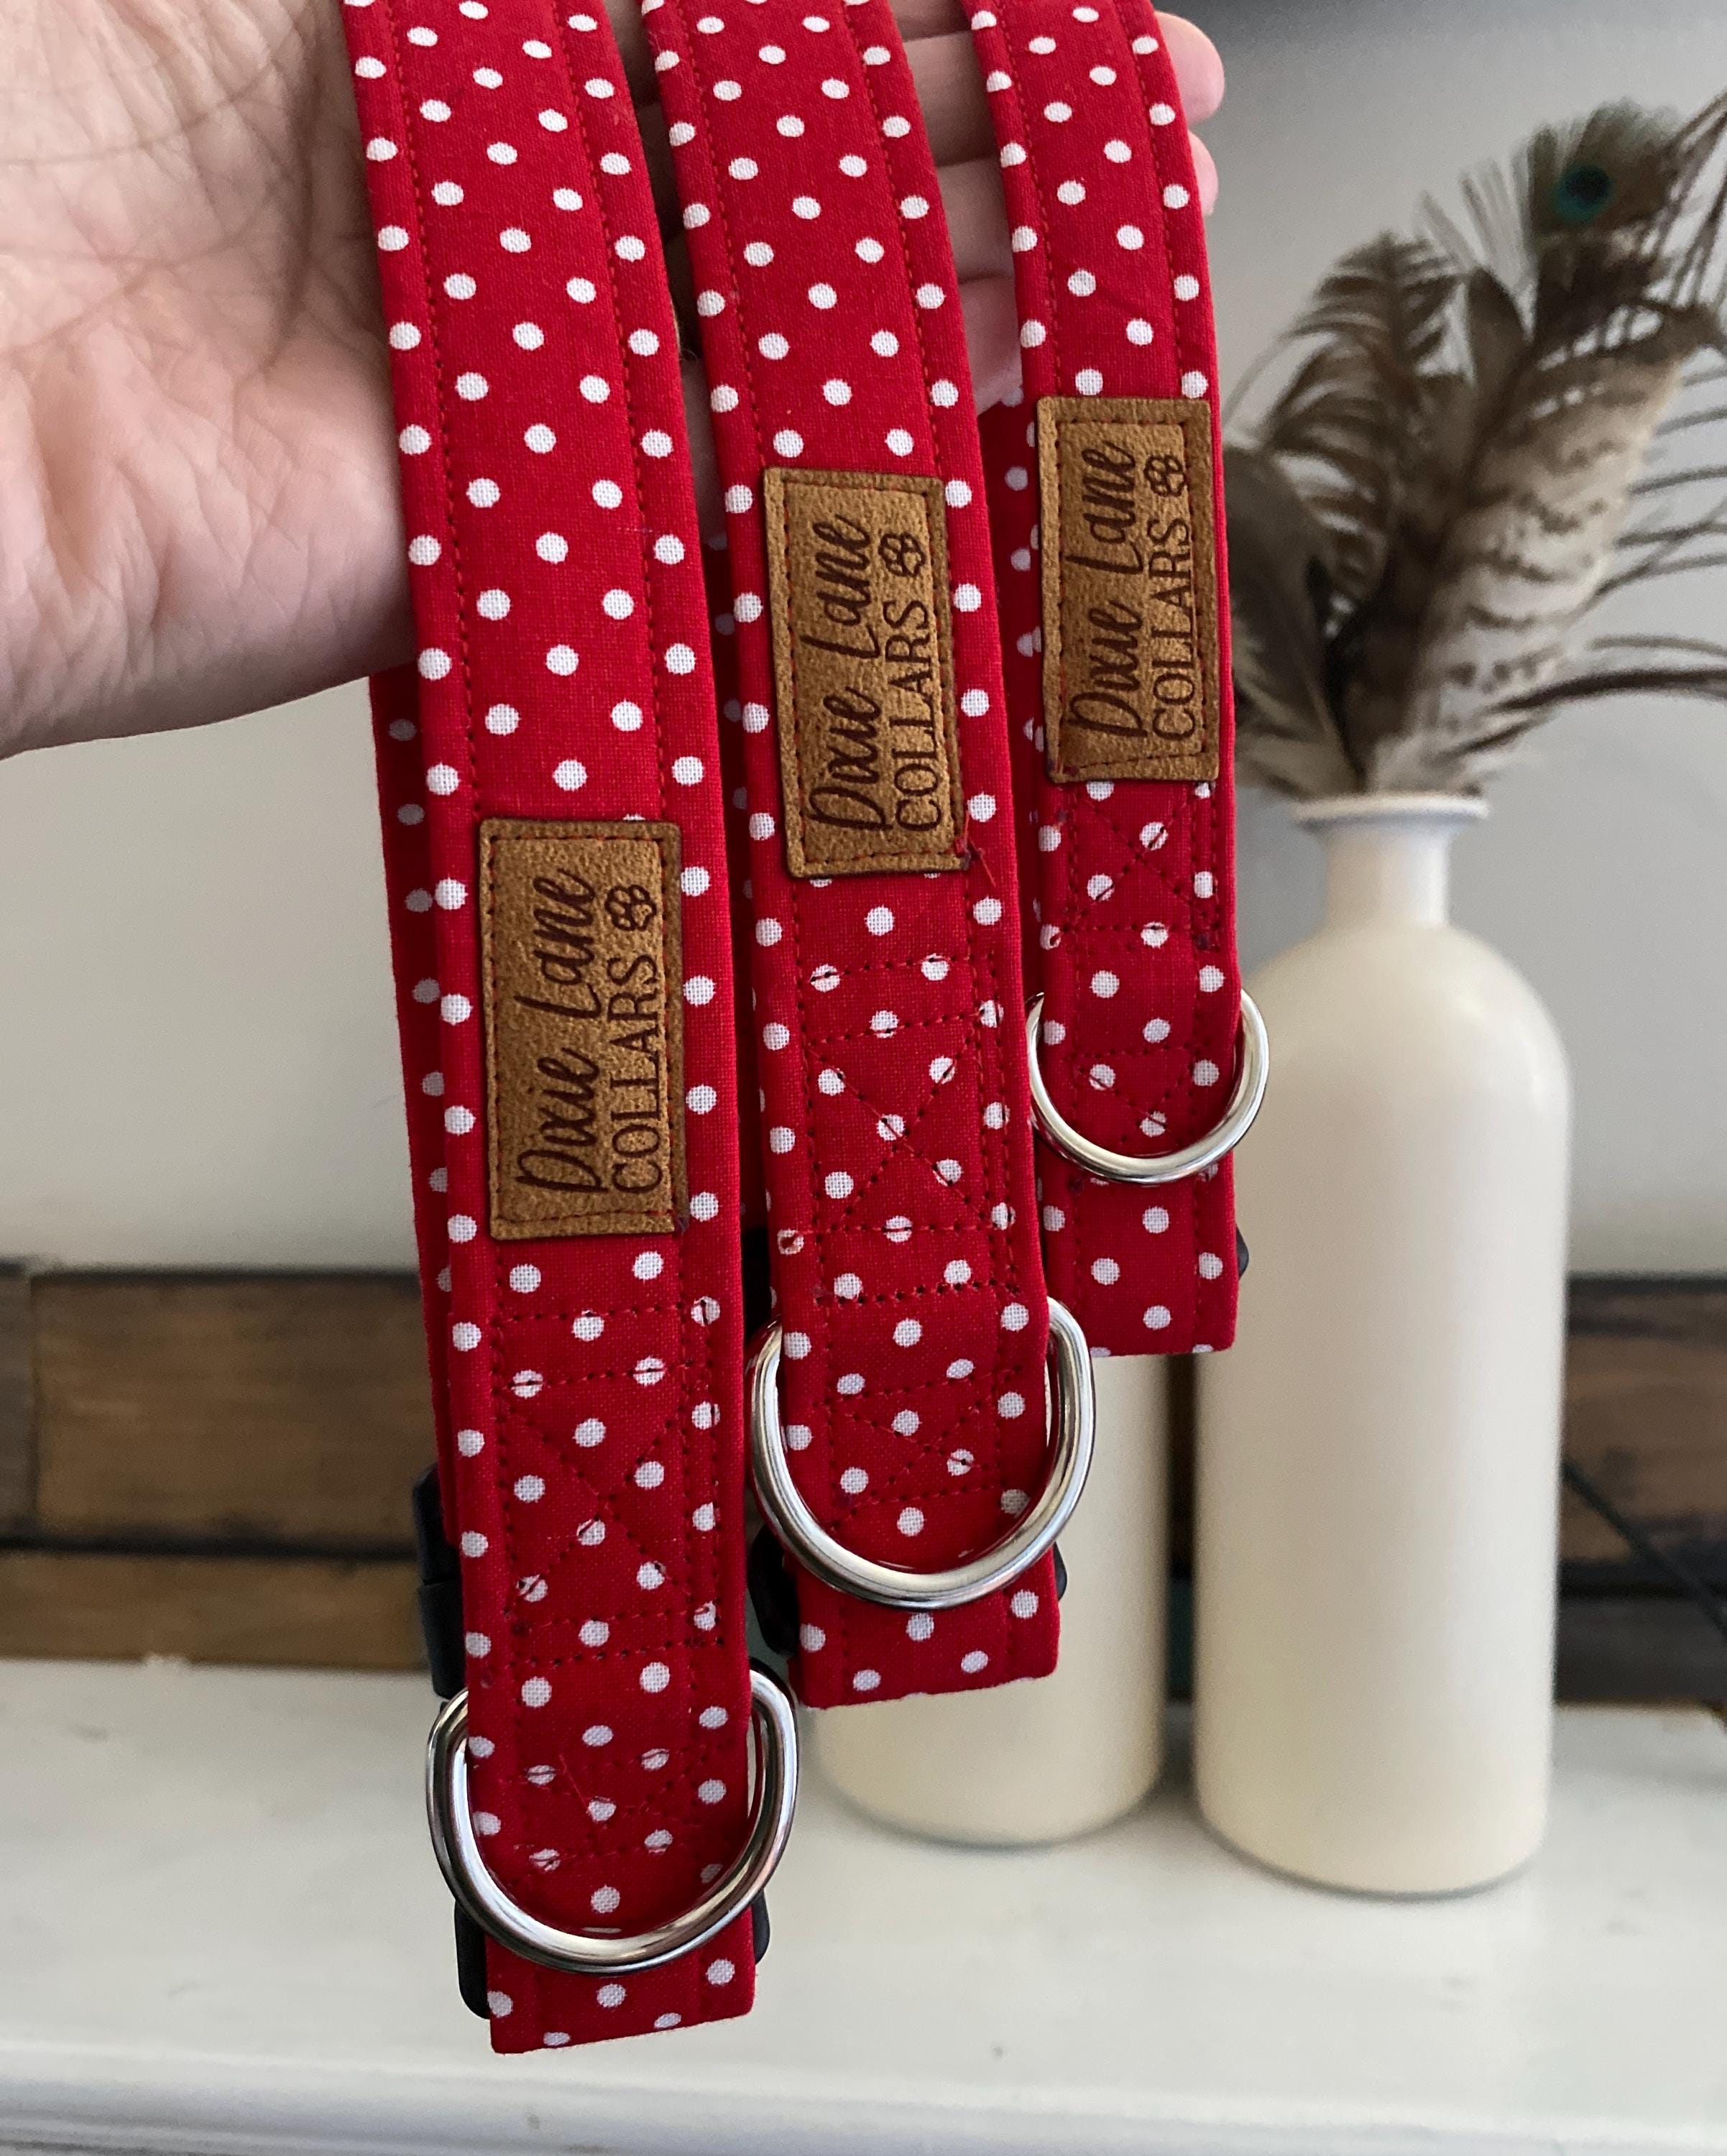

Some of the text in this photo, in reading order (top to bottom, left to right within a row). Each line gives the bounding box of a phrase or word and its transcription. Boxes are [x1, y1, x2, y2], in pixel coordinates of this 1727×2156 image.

[800, 514, 893, 831] Dixie Lane
[883, 599, 941, 832] COLLARS
[1064, 440, 1148, 738] Dixie Lane
[1148, 517, 1196, 741] COLLARS
[513, 867, 609, 1194] Dixie Lane
[607, 955, 663, 1194] COLLARS
